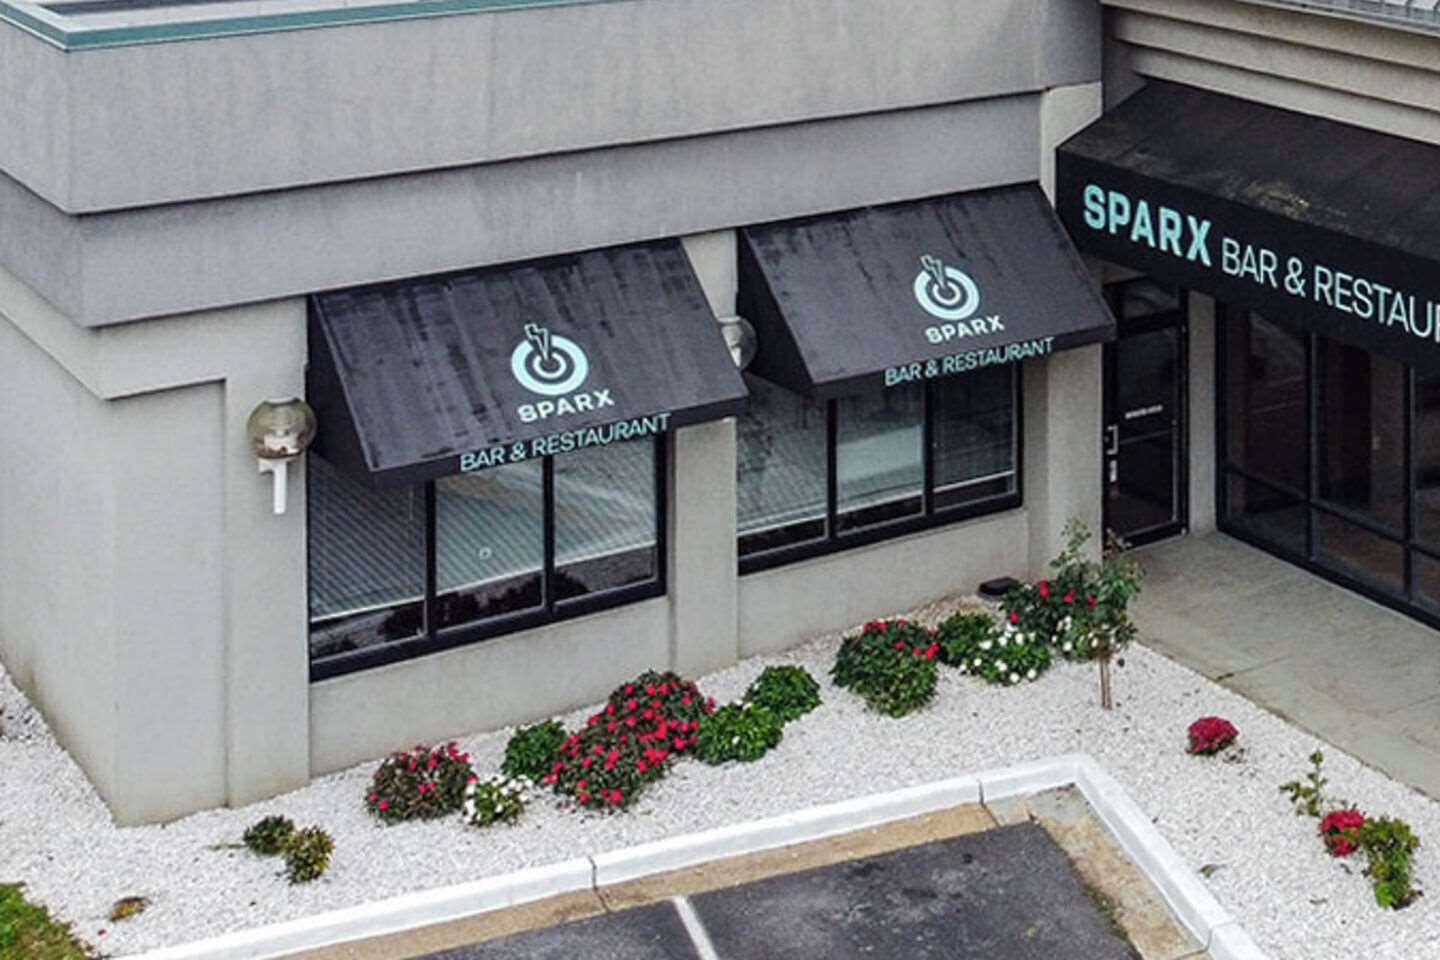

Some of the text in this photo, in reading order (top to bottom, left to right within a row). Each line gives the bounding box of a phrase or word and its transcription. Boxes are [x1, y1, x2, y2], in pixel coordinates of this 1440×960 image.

[1083, 184, 1212, 268] SPARX
[1221, 237, 1278, 289] BAR
[1283, 256, 1306, 298] &
[925, 315, 1005, 344] SPARX
[884, 337, 1055, 387] BAR & RESTAURANT
[517, 389, 615, 423] SPARX
[459, 413, 671, 473] BAR & RESTAURANT
